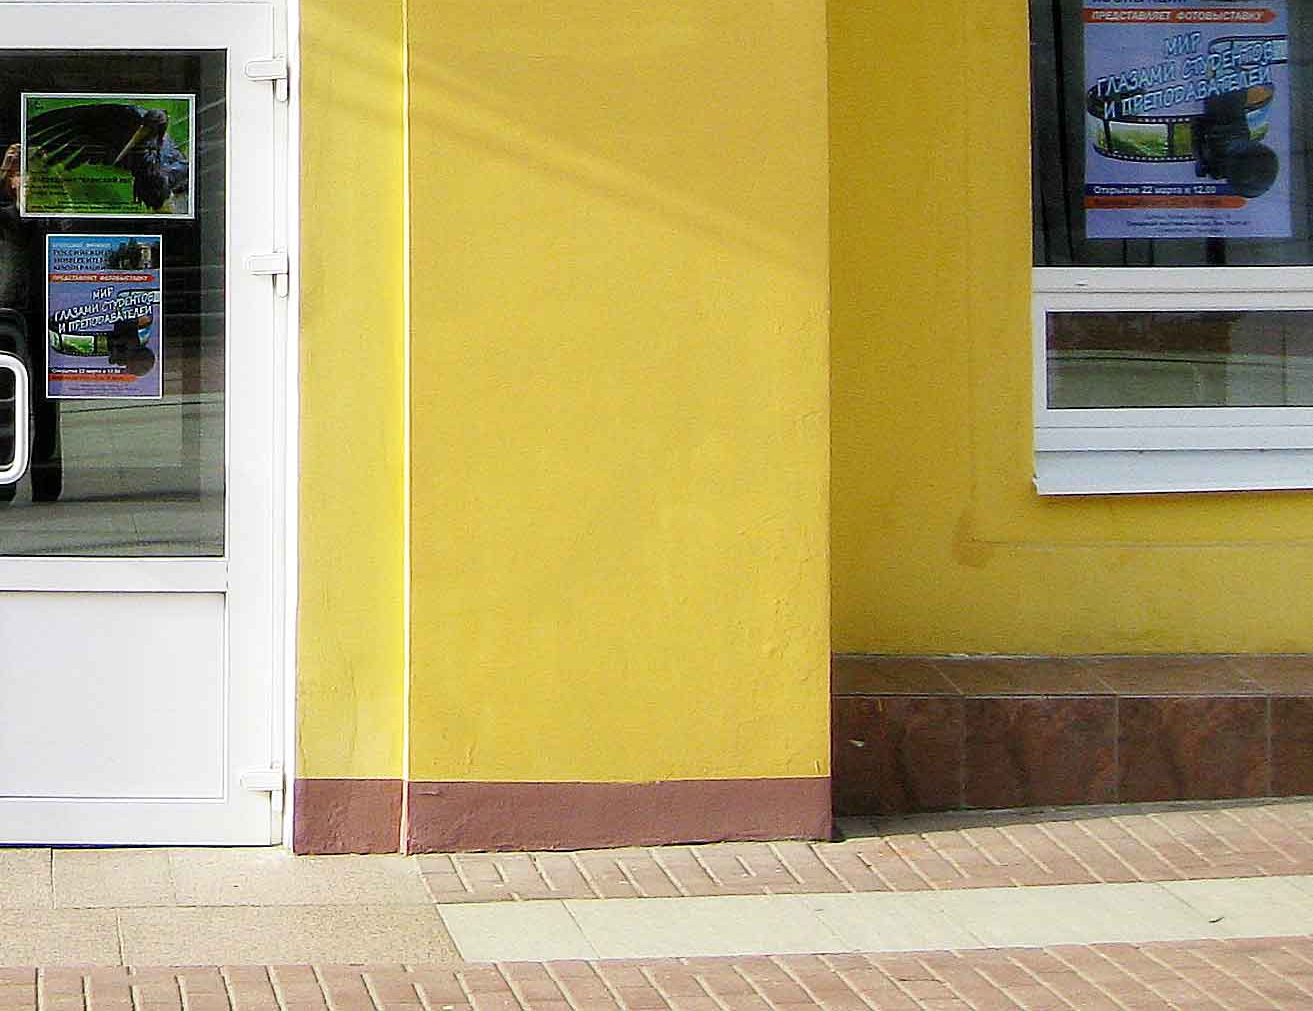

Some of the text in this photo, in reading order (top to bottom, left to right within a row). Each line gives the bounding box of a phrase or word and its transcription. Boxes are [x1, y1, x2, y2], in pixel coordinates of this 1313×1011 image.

[1163, 31, 1201, 56] МИР
[1097, 42, 1274, 97] ГЛАЗАМИ СТУДЕНТОВ
[1103, 66, 1274, 119] И ПРЕПОДАВАТЕЛЕЙ
[54, 292, 155, 323] ГЛАЗАМИ СТУДЕНТОВ
[91, 286, 115, 301] МИР
[58, 305, 153, 334] И ПРЕПОДАВАТЕЛЕЙ
